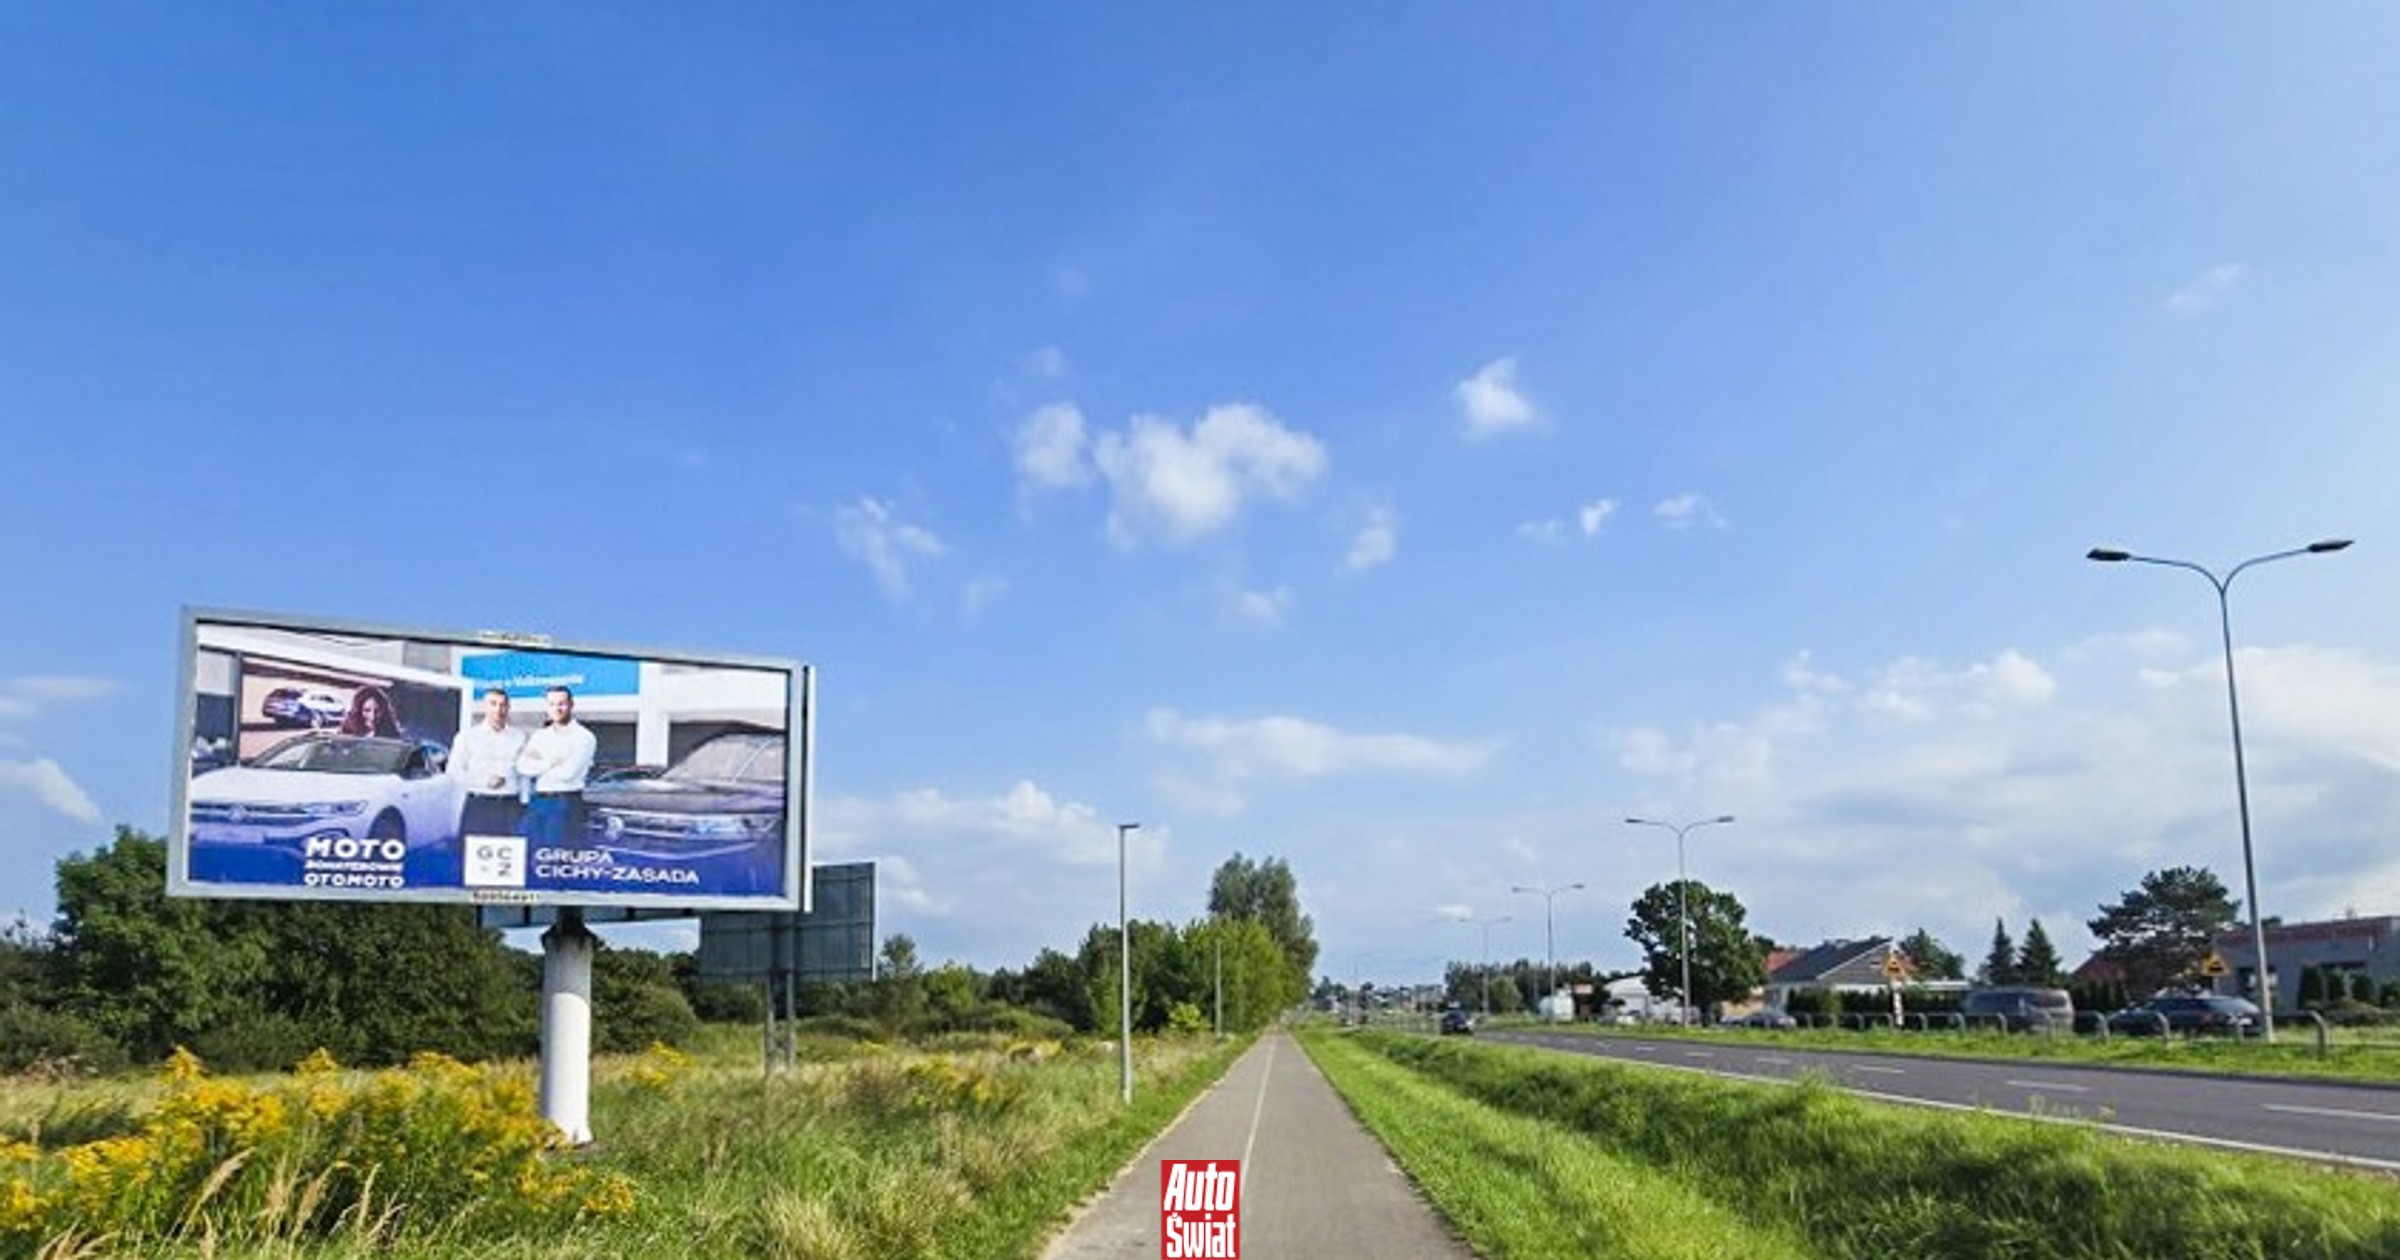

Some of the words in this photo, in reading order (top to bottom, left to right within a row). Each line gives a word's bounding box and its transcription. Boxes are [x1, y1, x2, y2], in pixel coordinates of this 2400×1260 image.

[305, 836, 405, 861] MOTO
[536, 847, 614, 864] GRUPA
[304, 872, 405, 889] OTOMOTO
[535, 864, 700, 884] CICHY-ZASADA
